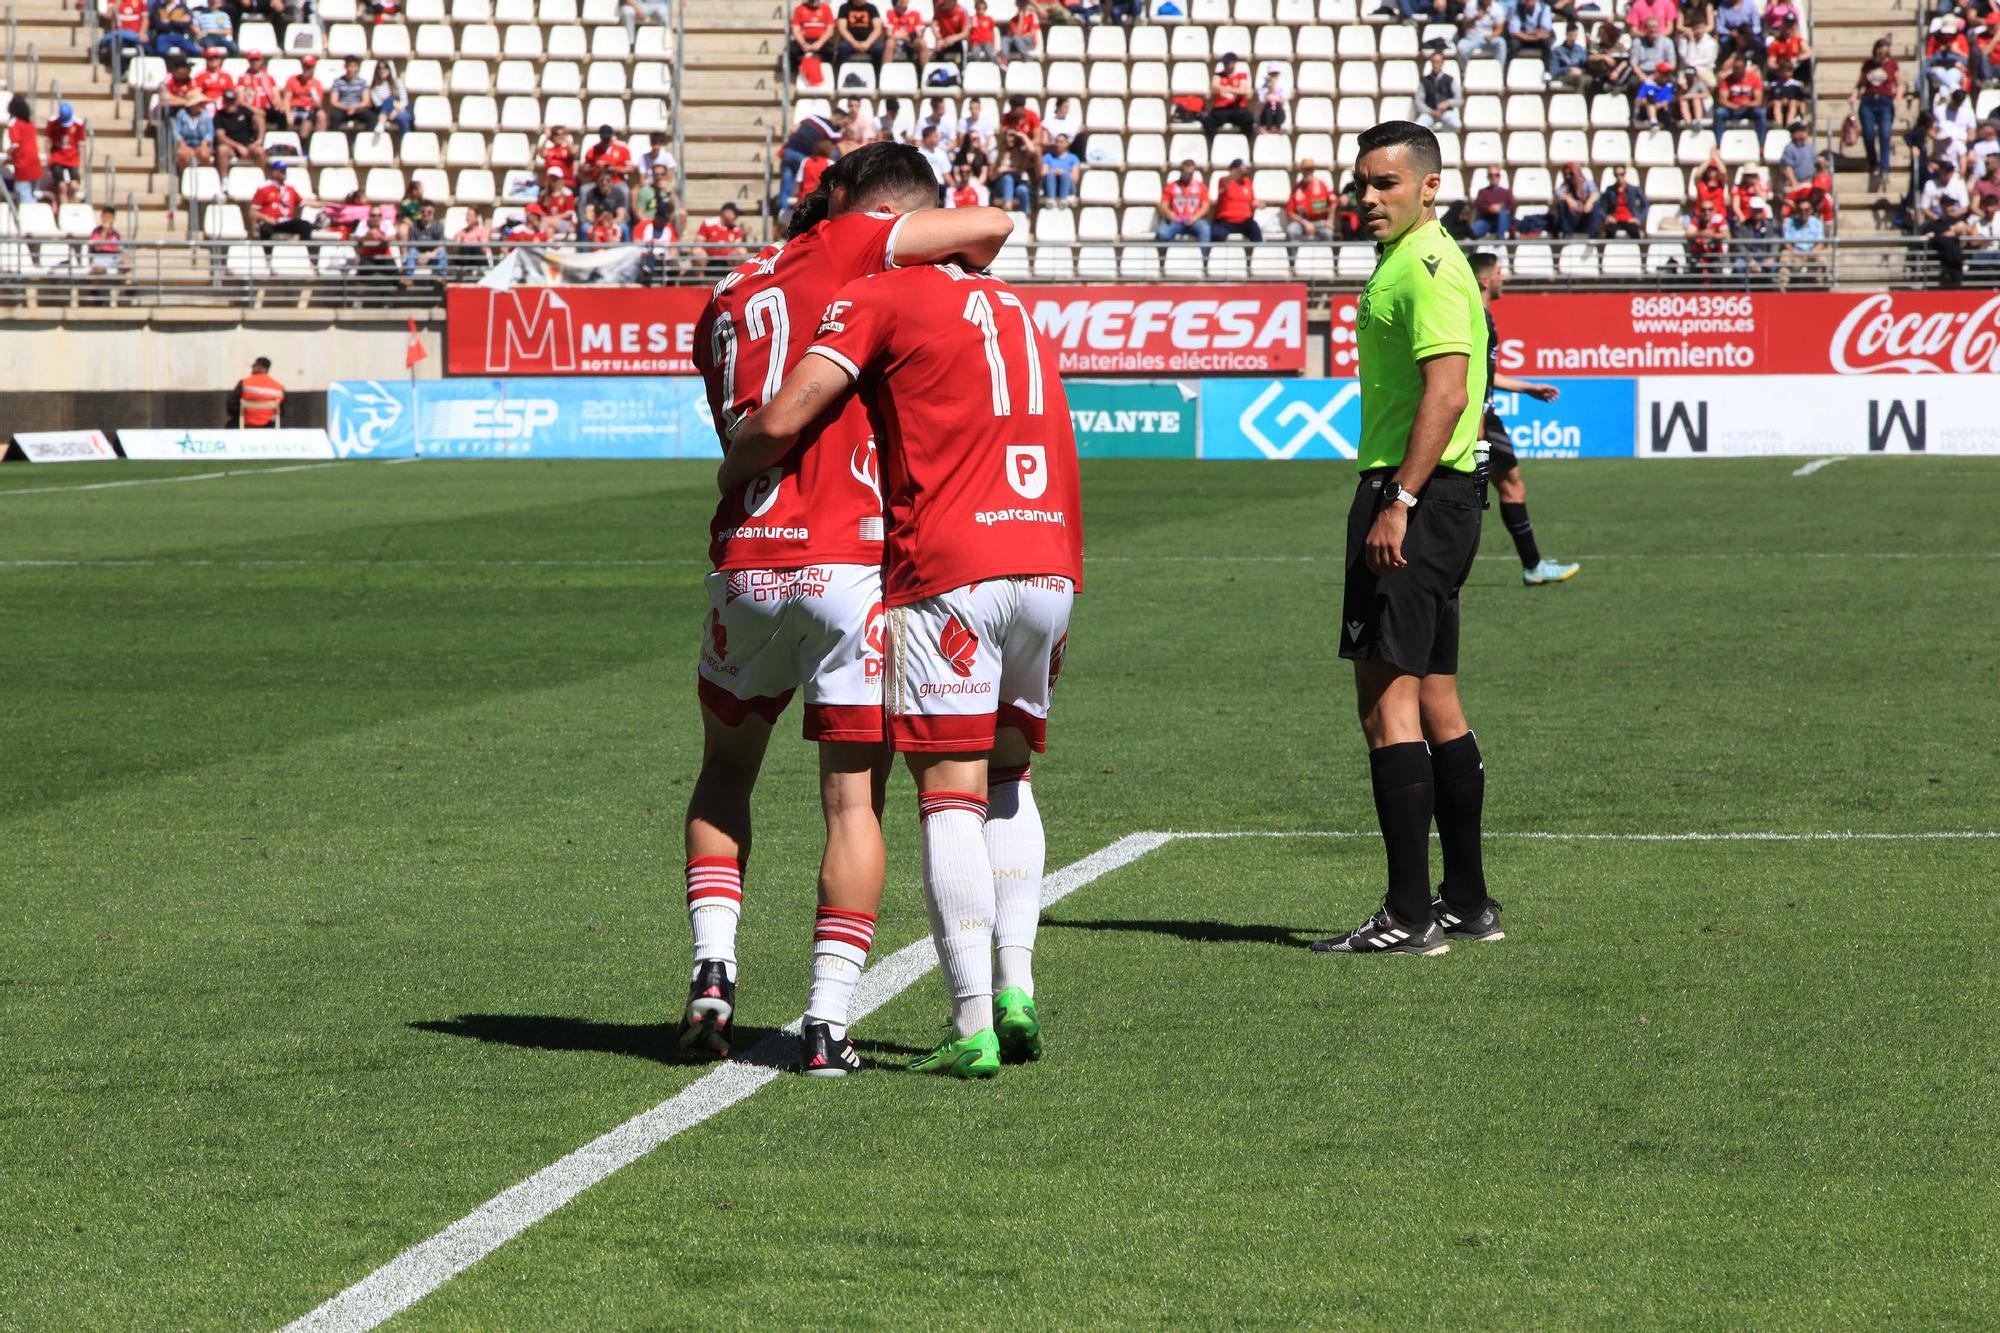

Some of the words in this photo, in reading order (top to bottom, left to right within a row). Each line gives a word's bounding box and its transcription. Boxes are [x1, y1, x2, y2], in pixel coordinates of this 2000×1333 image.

[1631, 297, 1753, 317] 868043966
[1034, 300, 1301, 349] MEFESA
[1632, 318, 1755, 336] www.prons.es
[963, 290, 1043, 416] 17
[1059, 353, 1164, 370] Materiales
[1169, 351, 1268, 370] eléctricos
[1537, 341, 1755, 369] mantenimiento
[750, 566, 833, 586] CONSTRU
[753, 582, 826, 602] OTAMAR
[920, 680, 991, 698] grupolucas
